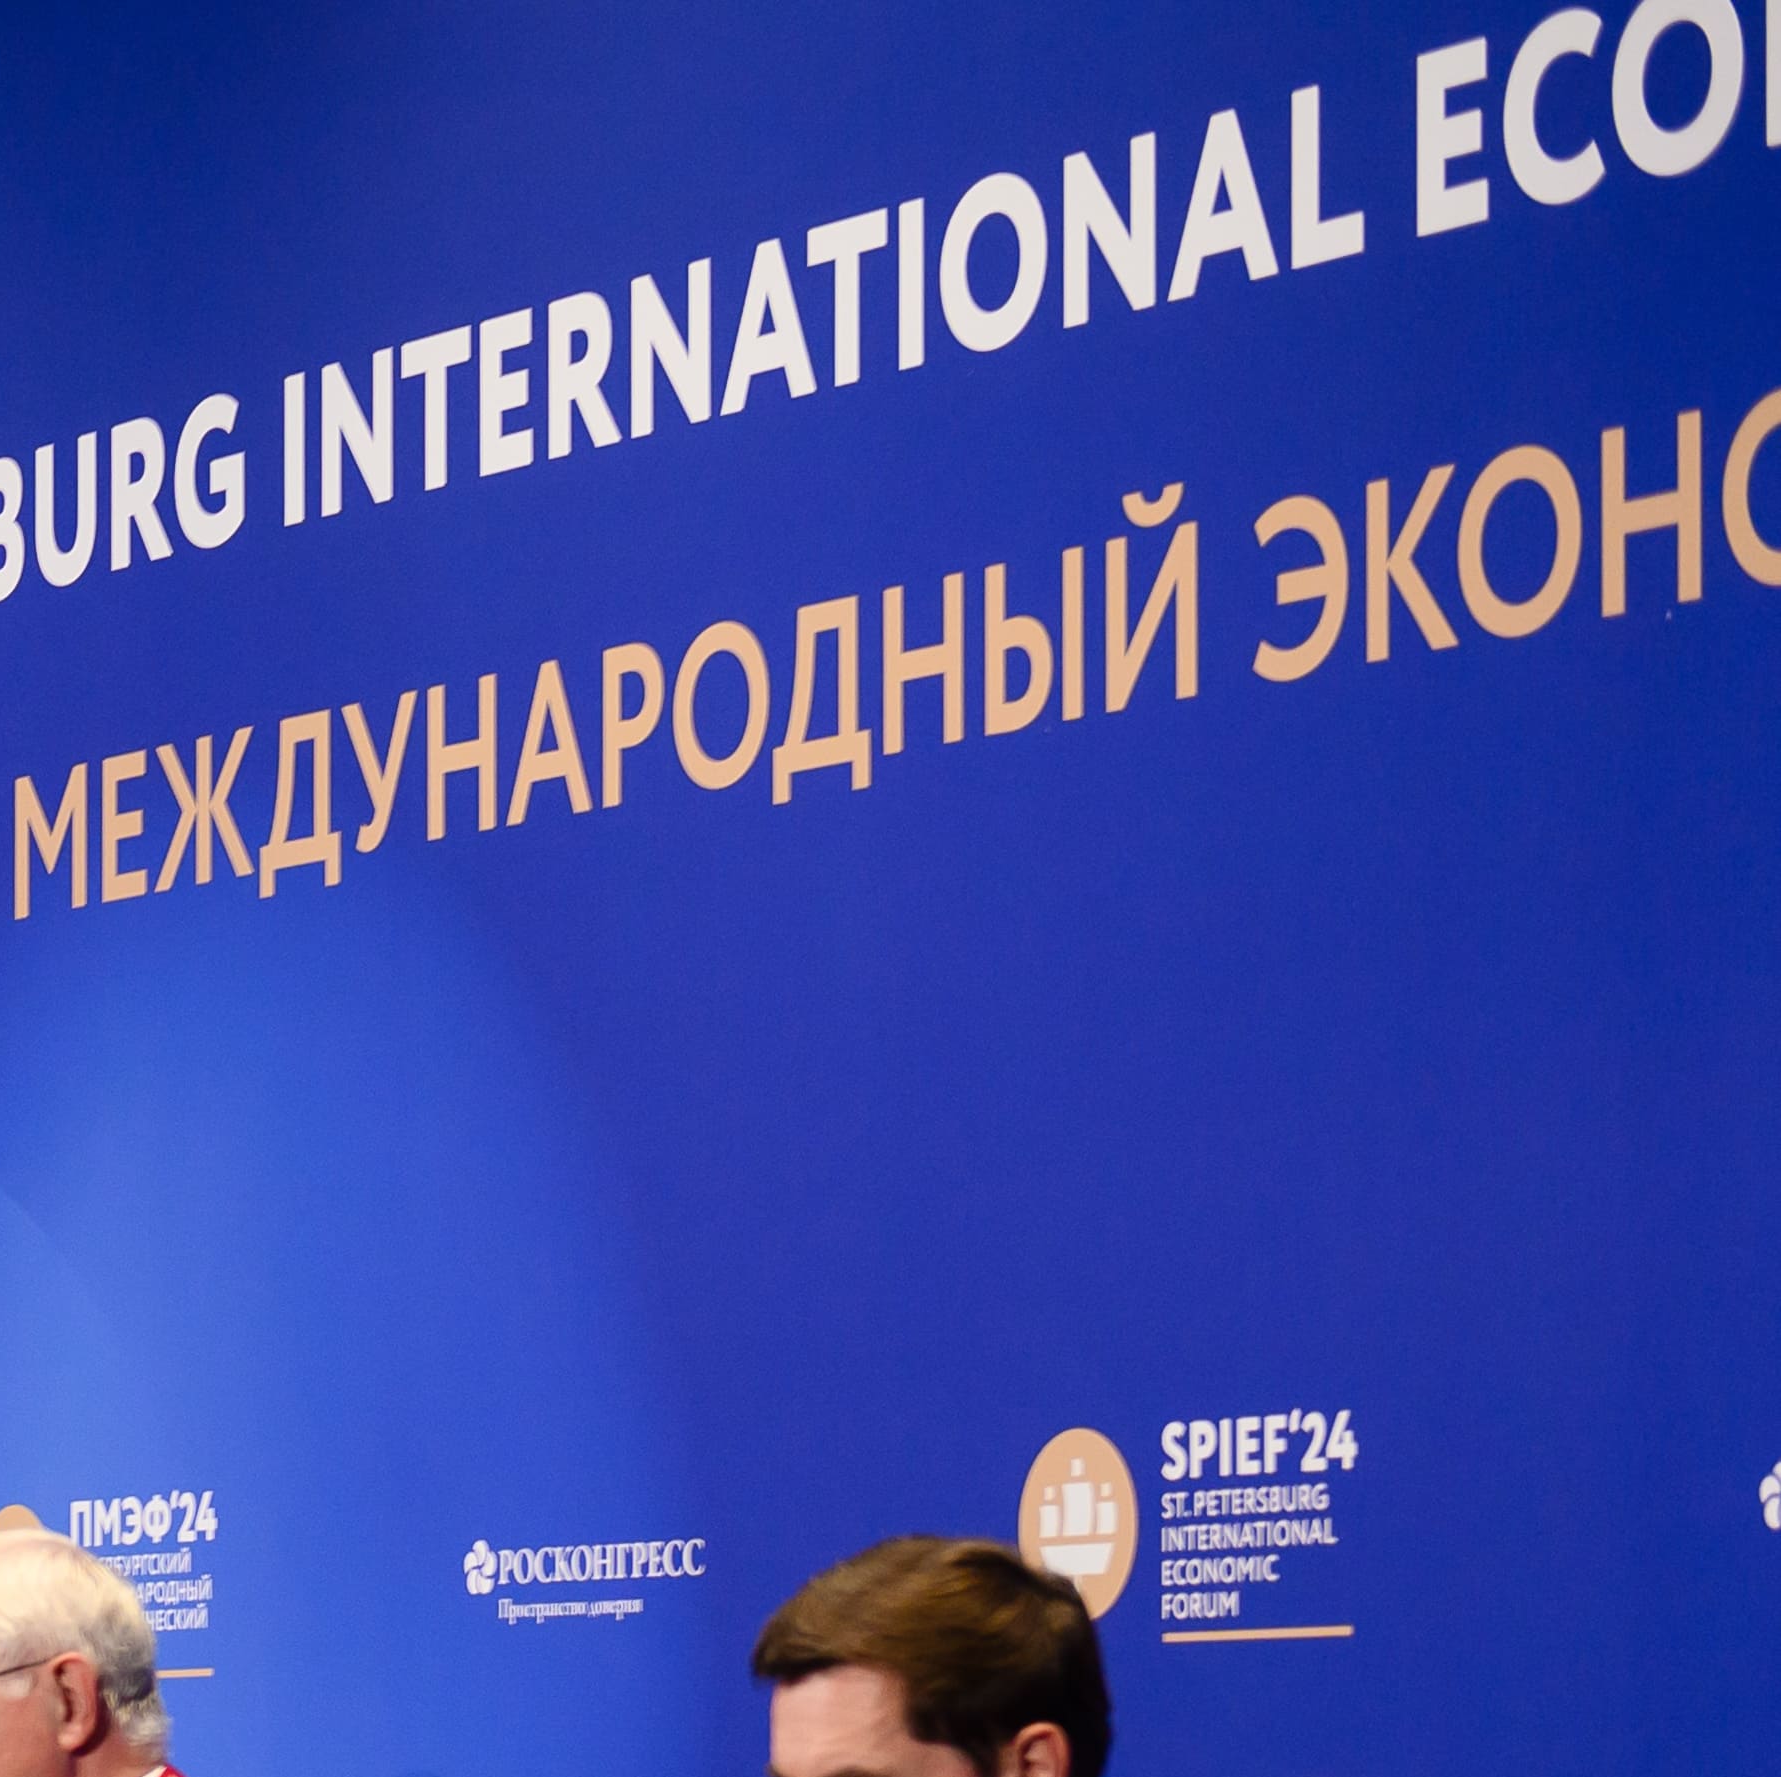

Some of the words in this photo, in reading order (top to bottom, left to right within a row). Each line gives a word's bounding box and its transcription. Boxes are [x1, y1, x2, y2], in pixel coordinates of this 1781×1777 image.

[285, 84, 1364, 526] INTERNATIONAL
[1416, 0, 1781, 237] ECO
[13, 482, 1198, 920] МЕЖДУНАРОДНЫЙ
[1161, 1408, 1358, 1482] SPIEF'24
[70, 1490, 218, 1547] ПМЭФ'24
[1160, 1491, 1190, 1520] ST.
[1194, 1483, 1329, 1516] PETERSBURG
[1161, 1517, 1339, 1553] INTERNATIONAL
[498, 1538, 707, 1585] РОСКОНГРЕСС
[1161, 1554, 1281, 1586] ECONOMIC
[1161, 1590, 1240, 1620] FORUM
